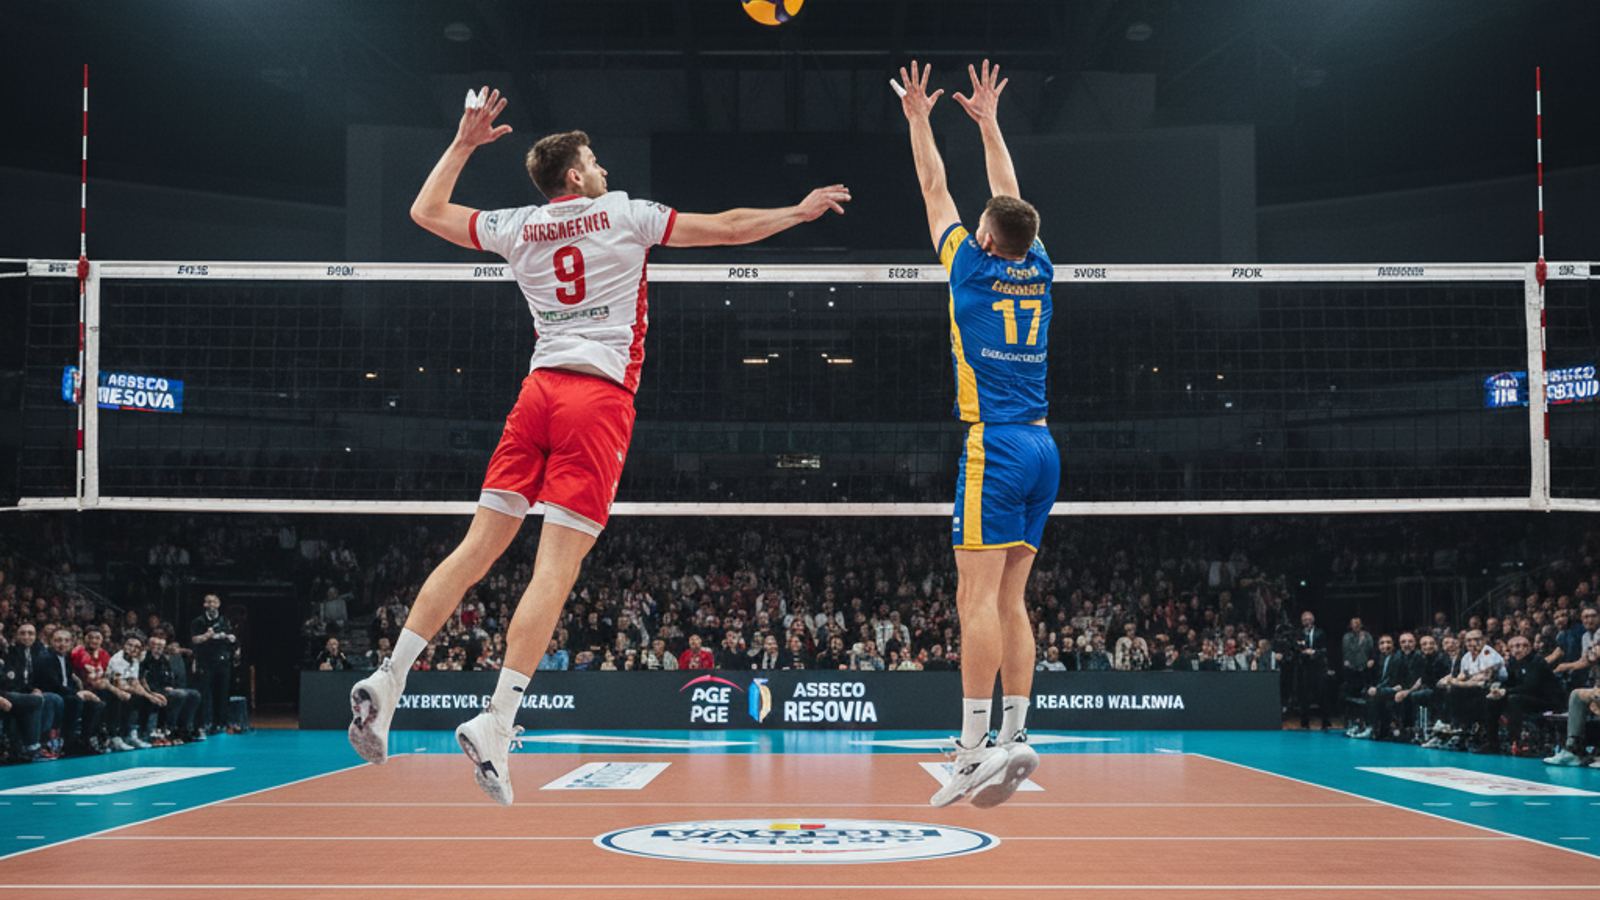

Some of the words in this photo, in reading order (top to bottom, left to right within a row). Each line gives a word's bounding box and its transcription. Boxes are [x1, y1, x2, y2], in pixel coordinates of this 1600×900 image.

[552, 245, 587, 305] 9
[992, 298, 1042, 346] 17
[691, 687, 732, 704] AGE
[793, 682, 865, 698] ASSECO
[690, 705, 729, 723] PGE
[784, 701, 878, 722] RESOVIA
